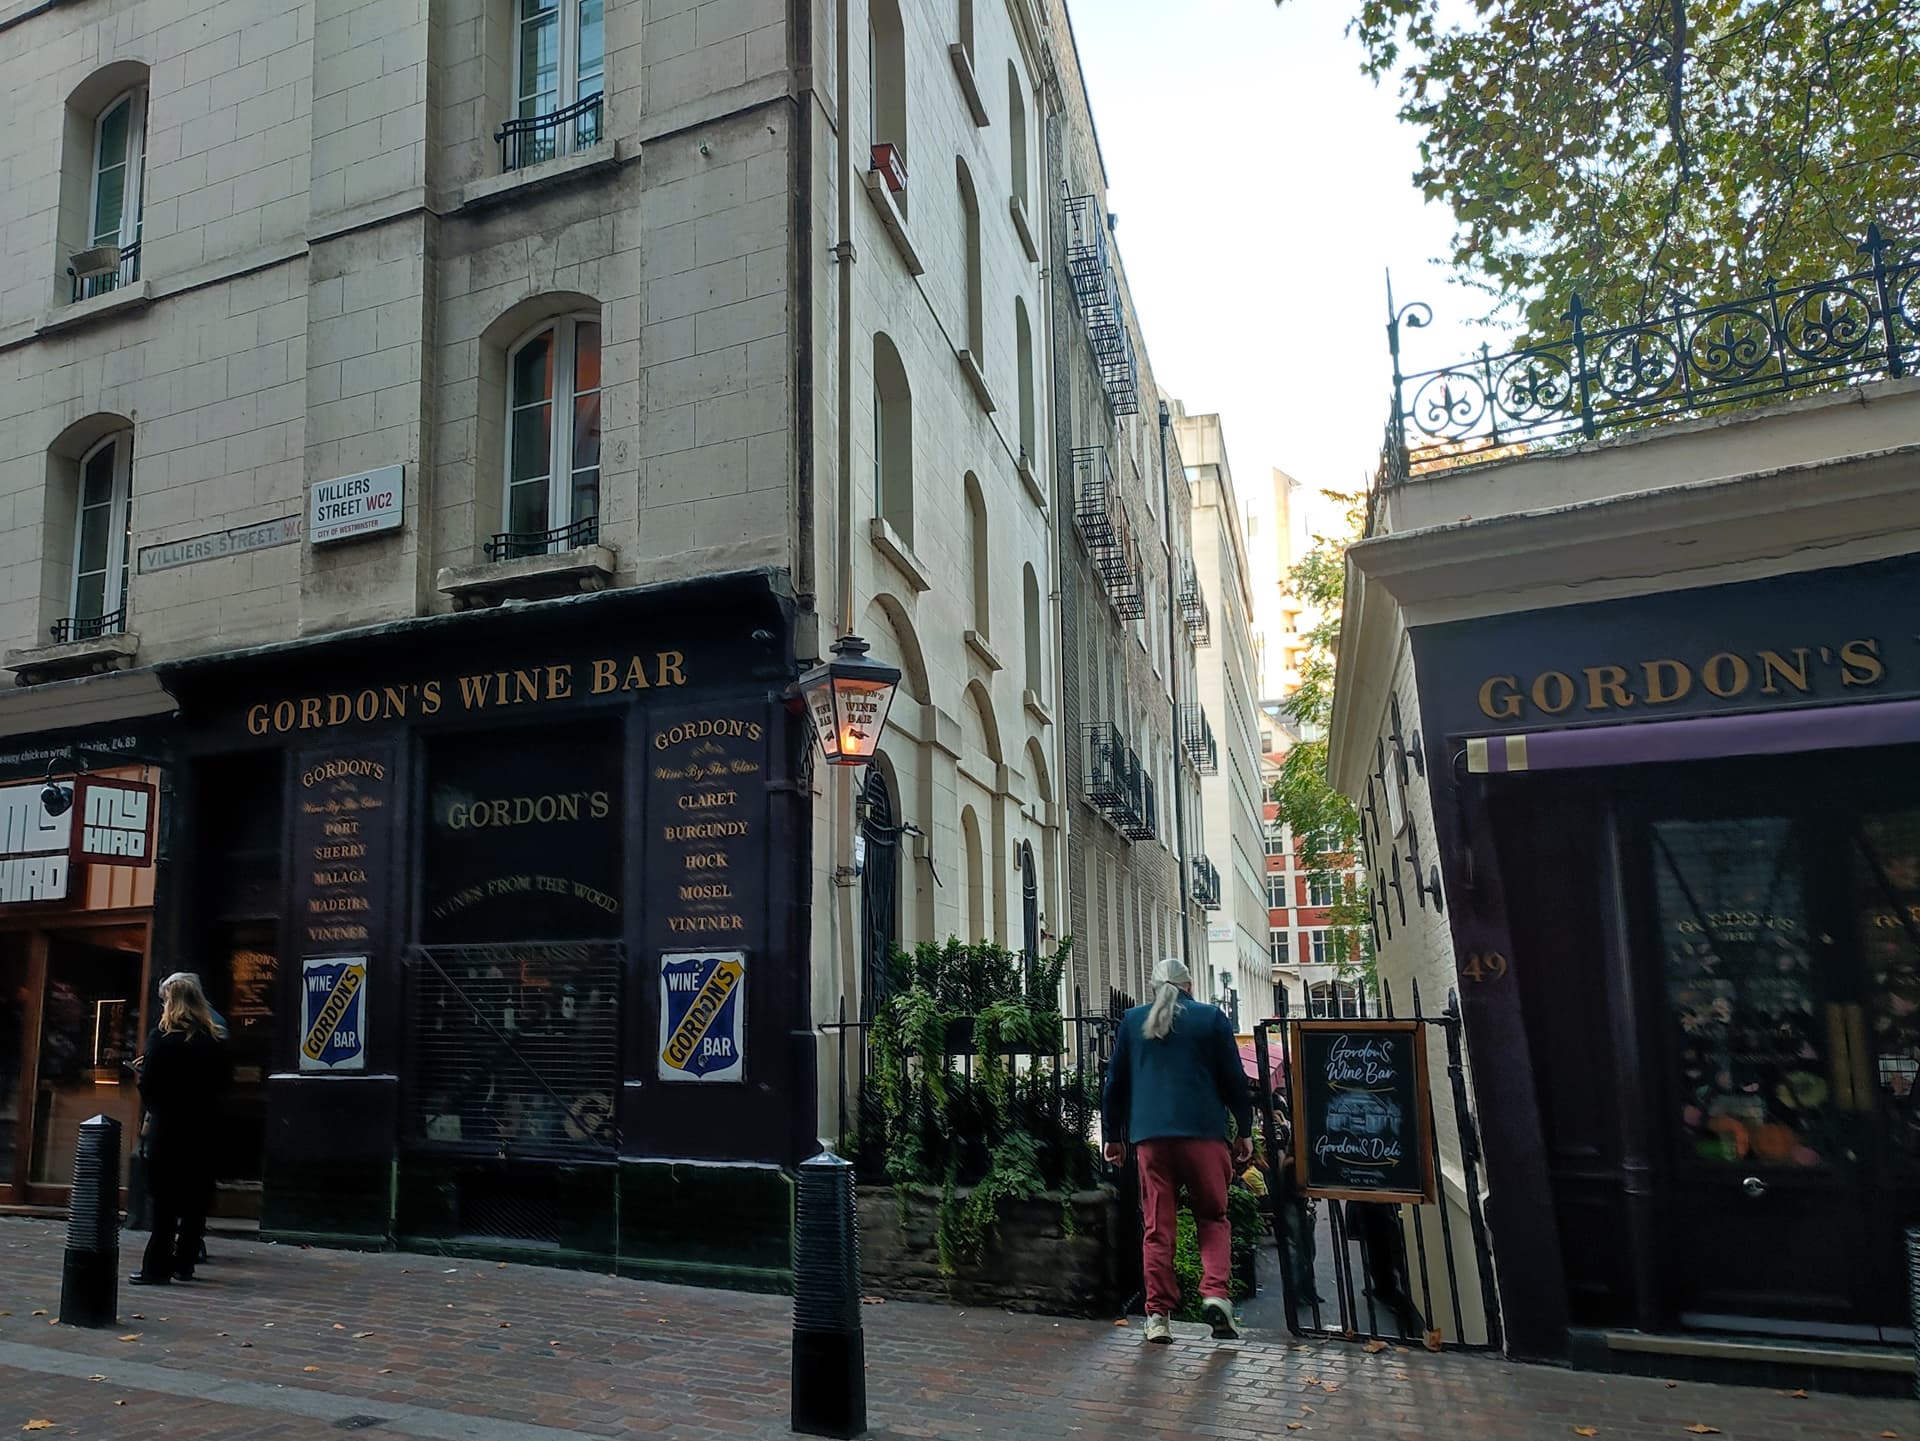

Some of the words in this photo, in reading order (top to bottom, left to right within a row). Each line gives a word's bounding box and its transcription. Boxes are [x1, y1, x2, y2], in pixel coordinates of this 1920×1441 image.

[318, 478, 370, 503] VILLIERS
[318, 499, 362, 521] STREET
[366, 492, 392, 511] WC2
[317, 529, 330, 538] CITY
[331, 527, 338, 536] OF
[340, 520, 379, 534] WESTMINSTER
[147, 540, 211, 567] VILLIERS
[1477, 637, 1886, 721] GORDON'S
[247, 680, 443, 736] GORDON'S
[458, 664, 573, 711] WINE
[590, 650, 688, 696] BAR
[845, 702, 877, 712] WINE
[848, 714, 872, 724] BAR
[655, 719, 762, 750] GORDON'S
[303, 760, 385, 788] GORDON'S
[679, 791, 737, 808] CLARET
[448, 791, 609, 830] GORDON'S
[324, 822, 359, 835] PORT
[665, 821, 748, 840] BURGUNDY
[313, 844, 368, 860] SHERRY
[685, 852, 728, 868] HOCK
[313, 870, 368, 885] MALAGA
[487, 874, 531, 896] FROM
[536, 875, 569, 894] THE
[572, 880, 619, 913] WOOD
[680, 884, 732, 900] MOSEL
[309, 896, 370, 913] MADEIRA
[666, 914, 744, 932] VINTNER
[1462, 952, 1507, 983] 49
[308, 975, 332, 992] WINE
[669, 972, 700, 991] WINE
[307, 970, 359, 1054] GORDON'S
[669, 966, 734, 1062] GORDON'S
[333, 1031, 356, 1048] BAR
[703, 1037, 731, 1056] BAR
[1326, 1061, 1363, 1080] Wine
[1365, 1061, 1397, 1084] Bar
[1370, 1138, 1401, 1159] Deli
